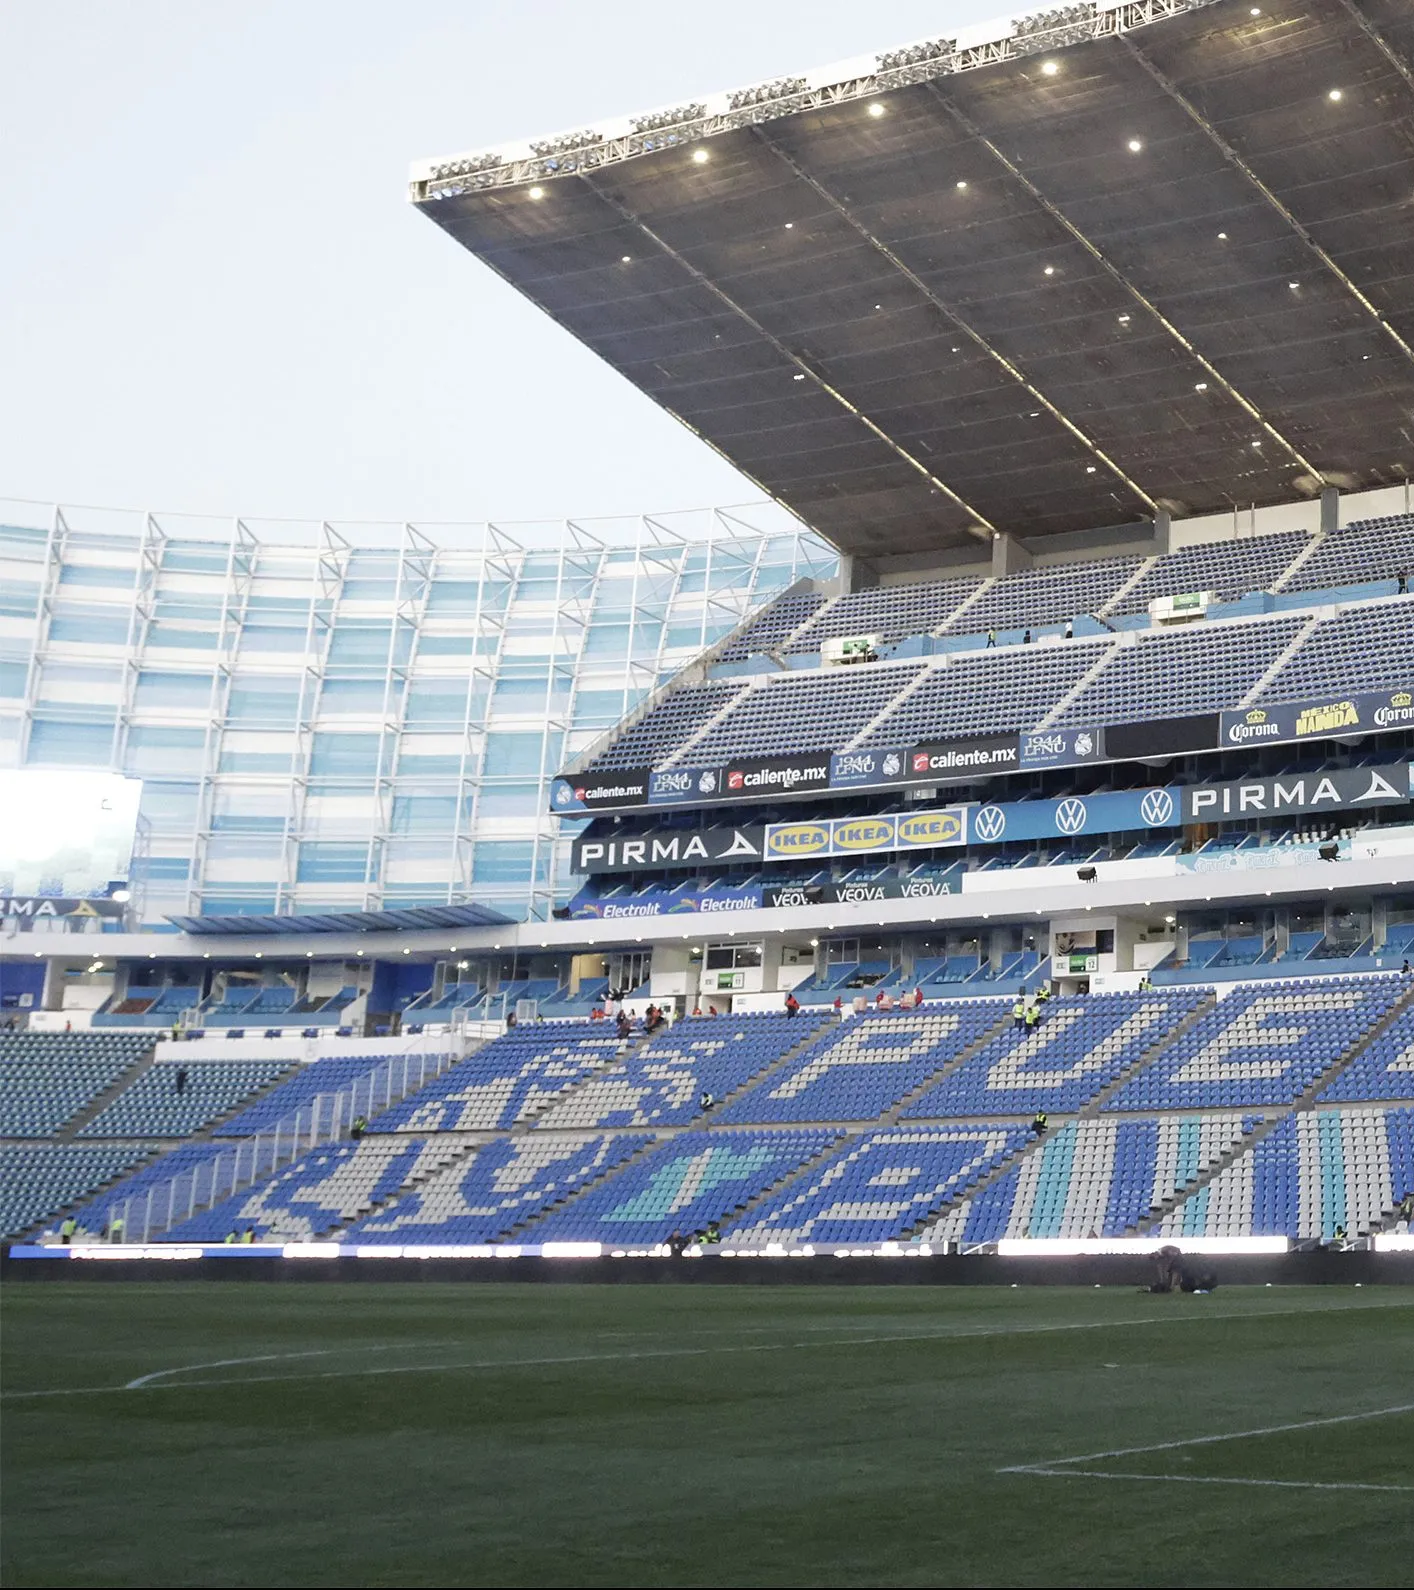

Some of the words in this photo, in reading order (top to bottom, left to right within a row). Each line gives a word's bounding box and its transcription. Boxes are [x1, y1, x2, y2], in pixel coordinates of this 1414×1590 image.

[1296, 707, 1359, 735] MANDA
[1028, 734, 1062, 747] 1944
[1229, 723, 1279, 743] Corona
[839, 755, 871, 767] 1944
[929, 747, 1016, 770] caliente.mx
[744, 766, 826, 787] caliente.mx
[585, 785, 643, 800] caliente.mx
[1192, 778, 1342, 817] PIRMA
[839, 826, 890, 842] IKEA
[904, 820, 956, 836] IKEA
[775, 832, 825, 847] IKEA
[580, 836, 709, 868] PIRMA
[603, 903, 661, 918] Electrolit
[700, 896, 757, 912] Electrolit
